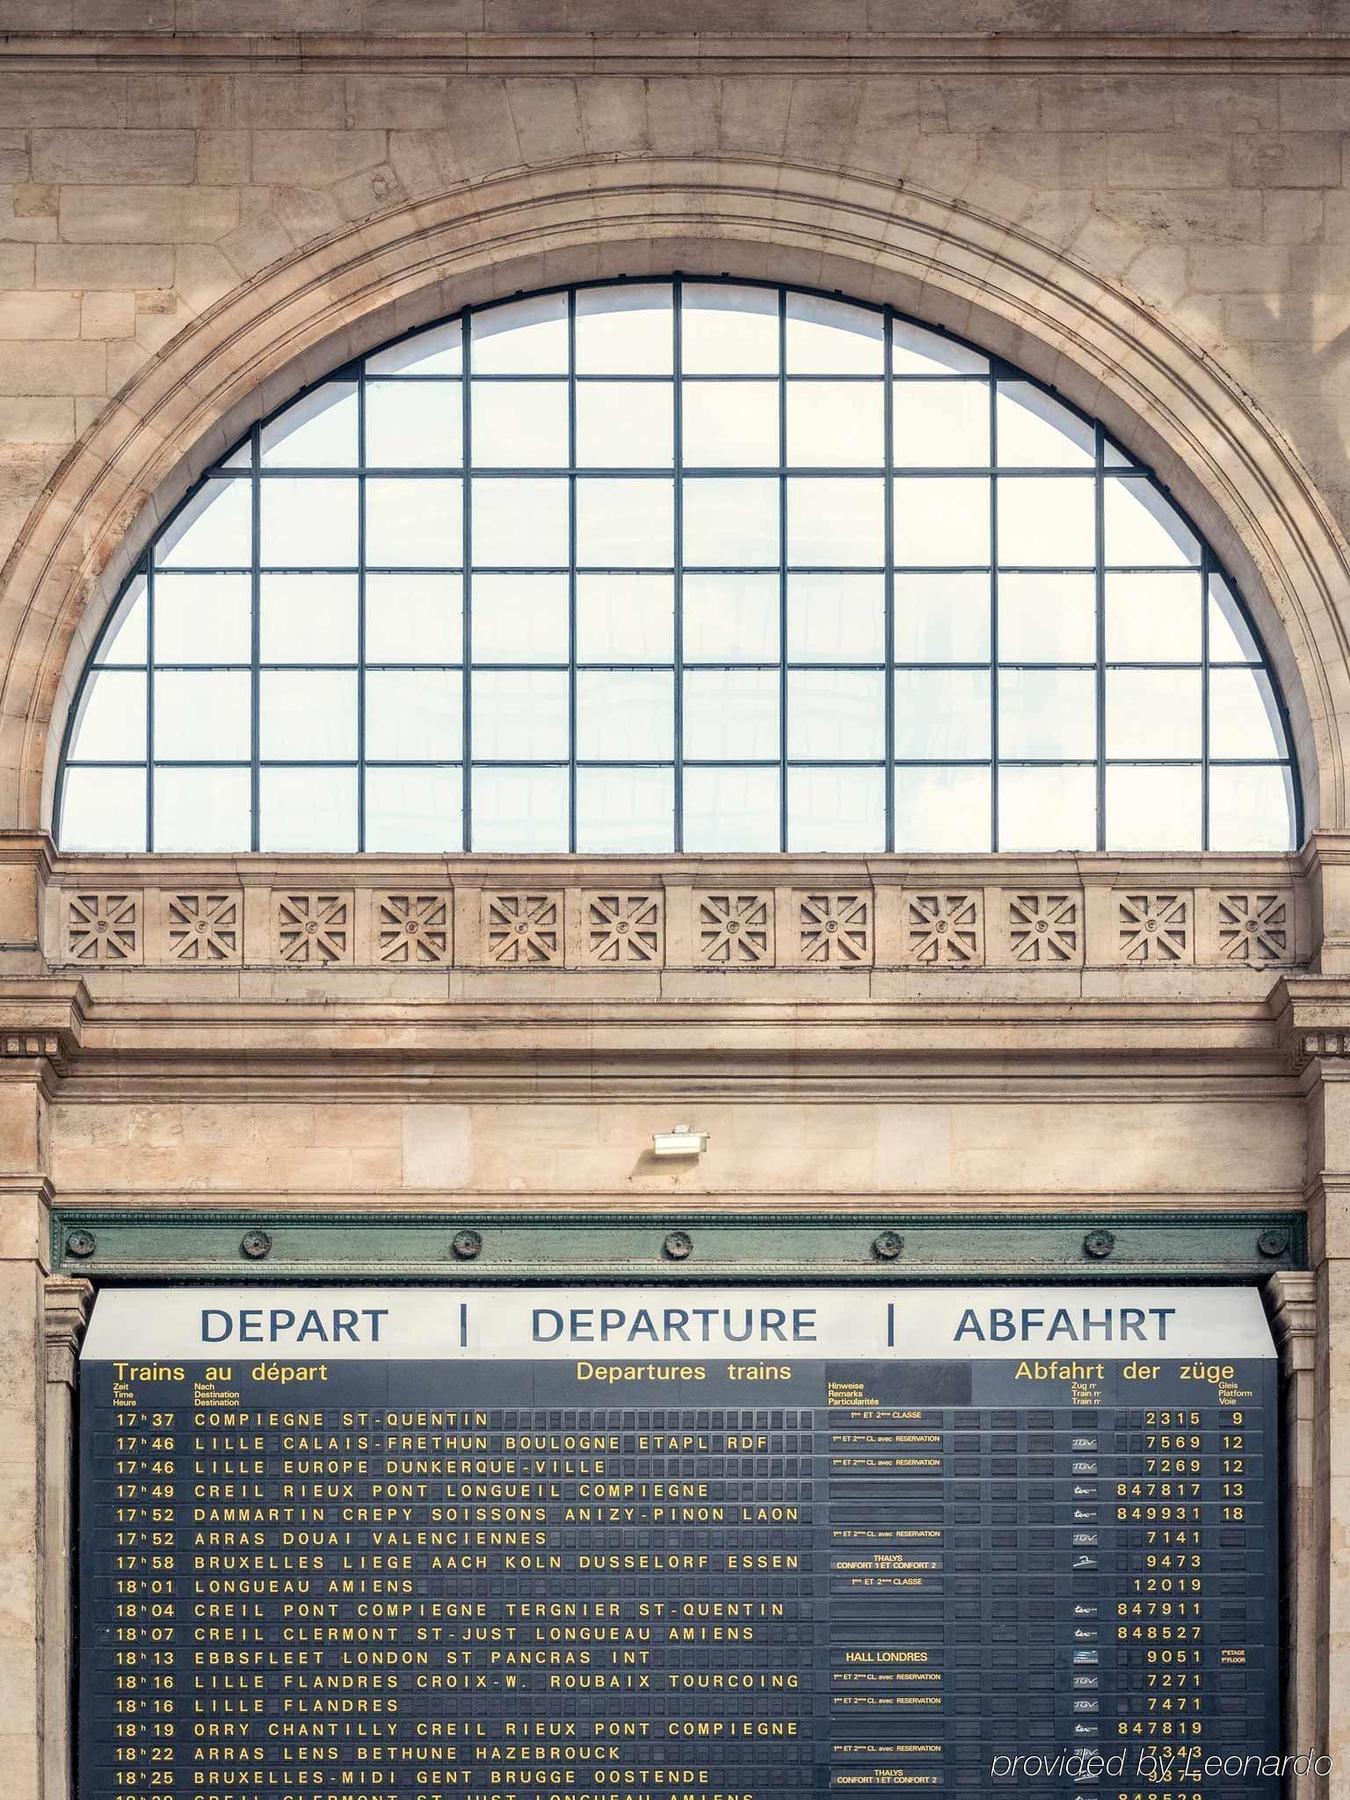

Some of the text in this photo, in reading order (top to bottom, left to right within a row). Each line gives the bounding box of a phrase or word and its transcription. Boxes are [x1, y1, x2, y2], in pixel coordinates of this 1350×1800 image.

[201, 1309, 389, 1343] DEPART
[532, 1308, 817, 1342] DEPARTURE
[953, 1308, 1176, 1342] ABFAHRT
[112, 1362, 328, 1384] Trains au départ
[576, 1360, 791, 1383] Departures trains
[1014, 1360, 1235, 1384] Abfahrt der züge
[112, 1382, 130, 1391] Zeit
[194, 1382, 215, 1391] Nach
[828, 1382, 865, 1390] Hinweise
[1071, 1381, 1088, 1391] Zug
[1218, 1381, 1239, 1390] Gleis
[112, 1390, 134, 1399] Time
[194, 1390, 240, 1399] Destination
[828, 1390, 864, 1398] Remarks
[1218, 1389, 1253, 1398] Platform
[112, 1398, 137, 1407] Heure
[194, 1398, 240, 1407] Destination
[828, 1398, 880, 1406] Particularités
[1072, 1397, 1092, 1405] Train
[1218, 1397, 1237, 1405] Voie
[194, 1413, 323, 1426] COMPIEGNE
[343, 1413, 487, 1426] ST-QUENTIN
[1146, 1412, 1200, 1425] 2315
[1232, 1412, 1243, 1425] 9
[195, 1437, 263, 1450] LILLE
[283, 1436, 487, 1450] CALAIS-FRETHUN
[505, 1436, 619, 1450] BOULOGNE
[639, 1436, 707, 1449] ETAPL
[727, 1436, 766, 1449] RDF
[895, 1435, 941, 1443] RESERVATION
[1147, 1436, 1200, 1448] 7569
[1224, 1436, 1242, 1449] 12
[195, 1461, 263, 1474] LILLE
[284, 1460, 367, 1474] EUROPE
[386, 1460, 604, 1474] DUNKERQUE-VILLE
[1147, 1459, 1200, 1472] 7269
[1224, 1459, 1243, 1473] 12
[194, 1484, 263, 1498] CREIL
[283, 1484, 353, 1497] RIEUX
[372, 1484, 427, 1498] PONT
[447, 1484, 560, 1498] LONGUEIL
[579, 1484, 707, 1497] COMPIEGNE
[1117, 1483, 1200, 1496] 847817
[1224, 1483, 1243, 1497] 13
[194, 1508, 324, 1521] DAMMARTIN
[343, 1508, 412, 1521] CREPY
[431, 1507, 546, 1521] SOISSONS
[565, 1507, 724, 1521] ANIZY-PINON
[743, 1508, 798, 1521] LAON
[1117, 1507, 1199, 1520] 849931
[1223, 1507, 1243, 1520] 18
[195, 1532, 265, 1545] ARRAS
[283, 1532, 350, 1545] DOUAI
[373, 1532, 546, 1545] VALENCIENNES
[1147, 1531, 1199, 1544] 7141
[194, 1556, 324, 1569] BRUXELLES
[343, 1556, 412, 1569] LIEGE
[432, 1555, 487, 1569] AACH
[505, 1556, 561, 1569] KOLN
[579, 1555, 708, 1569] DUSSELORF
[728, 1555, 798, 1569] ESSEN
[836, 1562, 872, 1570] CONFORT
[893, 1562, 929, 1570] CONFORT
[1147, 1555, 1201, 1568] 9473
[195, 1580, 309, 1593] LONGUEAU
[328, 1579, 413, 1593] AMIENS
[1134, 1578, 1201, 1591] 12019
[194, 1604, 263, 1617] CREIL
[283, 1604, 338, 1617] PONT
[358, 1603, 486, 1617] COMPIEGNE
[506, 1603, 620, 1617] TERGNIER
[639, 1603, 783, 1616] ST-QUENTIN
[1118, 1602, 1199, 1616] 847911
[194, 1627, 263, 1641] CREIL
[283, 1627, 398, 1641] CLERMONT
[417, 1627, 516, 1641] ST-JUST
[536, 1627, 650, 1641] LONGUEAU
[669, 1627, 753, 1640] AMIENS
[1118, 1626, 1201, 1639] 848527
[195, 1651, 323, 1665] EBBSFLEET
[343, 1651, 428, 1665] LONDON
[447, 1651, 472, 1664] ST
[491, 1651, 590, 1664] PANCRAS
[612, 1651, 649, 1664] INT
[846, 1652, 928, 1662] HALL LONDRES
[1147, 1650, 1199, 1663] 9051
[195, 1675, 263, 1688] LILLE
[284, 1675, 398, 1688] FLANDRES
[417, 1675, 525, 1688] CROIX-W.
[550, 1675, 650, 1688] ROUBAIX
[669, 1675, 798, 1687] TOURCOING
[1148, 1674, 1200, 1687] 7271
[195, 1699, 263, 1712] LILLE
[284, 1699, 398, 1712] FLANDRES
[1148, 1698, 1200, 1710] 7471
[194, 1723, 249, 1737] ORRY
[268, 1723, 397, 1736] CHANTILLY
[416, 1723, 485, 1736] CREIL
[505, 1722, 575, 1736] RIEUX
[594, 1722, 649, 1735] PONT
[668, 1722, 797, 1736] COMPIEGNE
[1118, 1722, 1202, 1735] 847819
[194, 1747, 264, 1760] ARRAS
[284, 1747, 338, 1760] LENS
[357, 1747, 456, 1760] BETHUNE
[476, 1746, 620, 1760] HAZEBROUCK
[194, 1771, 394, 1784] BRUXELLES-MIDI
[416, 1770, 472, 1784] GENT
[491, 1770, 575, 1784] BRUGGE
[594, 1770, 708, 1784] OOSTENDE
